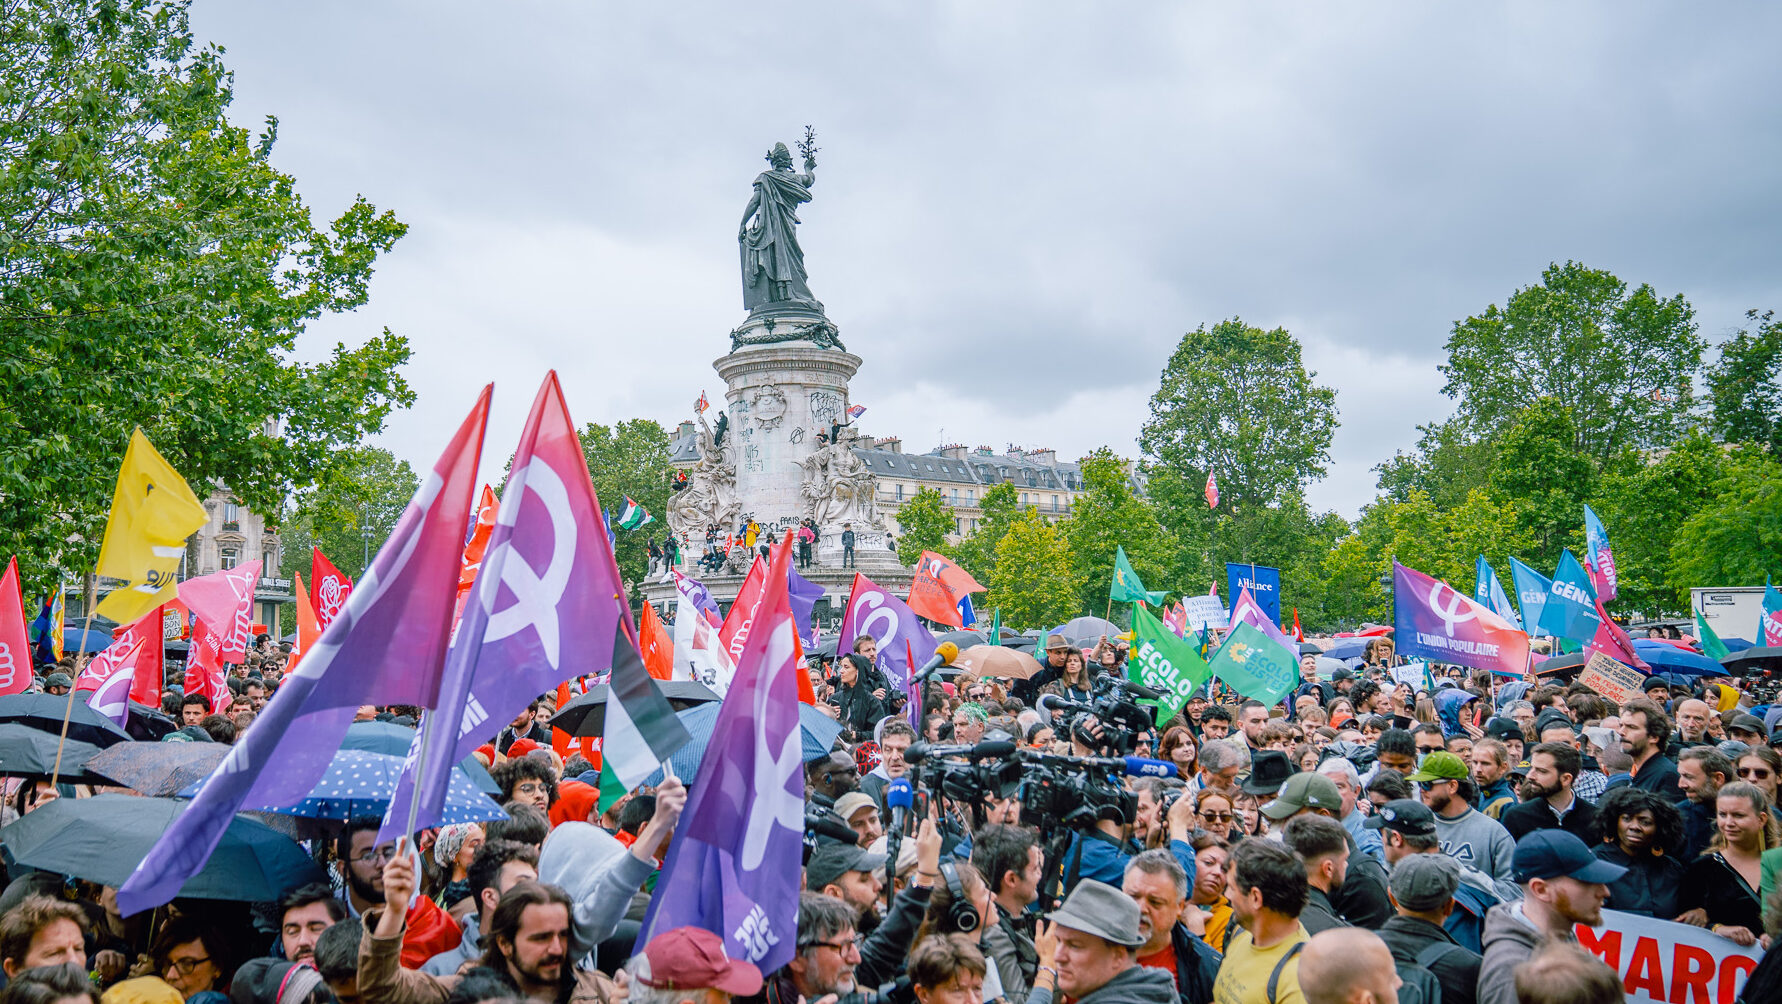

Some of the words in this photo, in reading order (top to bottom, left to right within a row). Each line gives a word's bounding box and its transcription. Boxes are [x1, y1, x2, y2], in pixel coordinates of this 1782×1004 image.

[1237, 577, 1273, 591] Allince
[1417, 632, 1448, 648] L'UNION
[1448, 639, 1499, 657] POPULAIRE
[1602, 679, 1625, 693] FRONT
[1141, 764, 1158, 774] AFP
[1438, 840, 1475, 860] ILA
